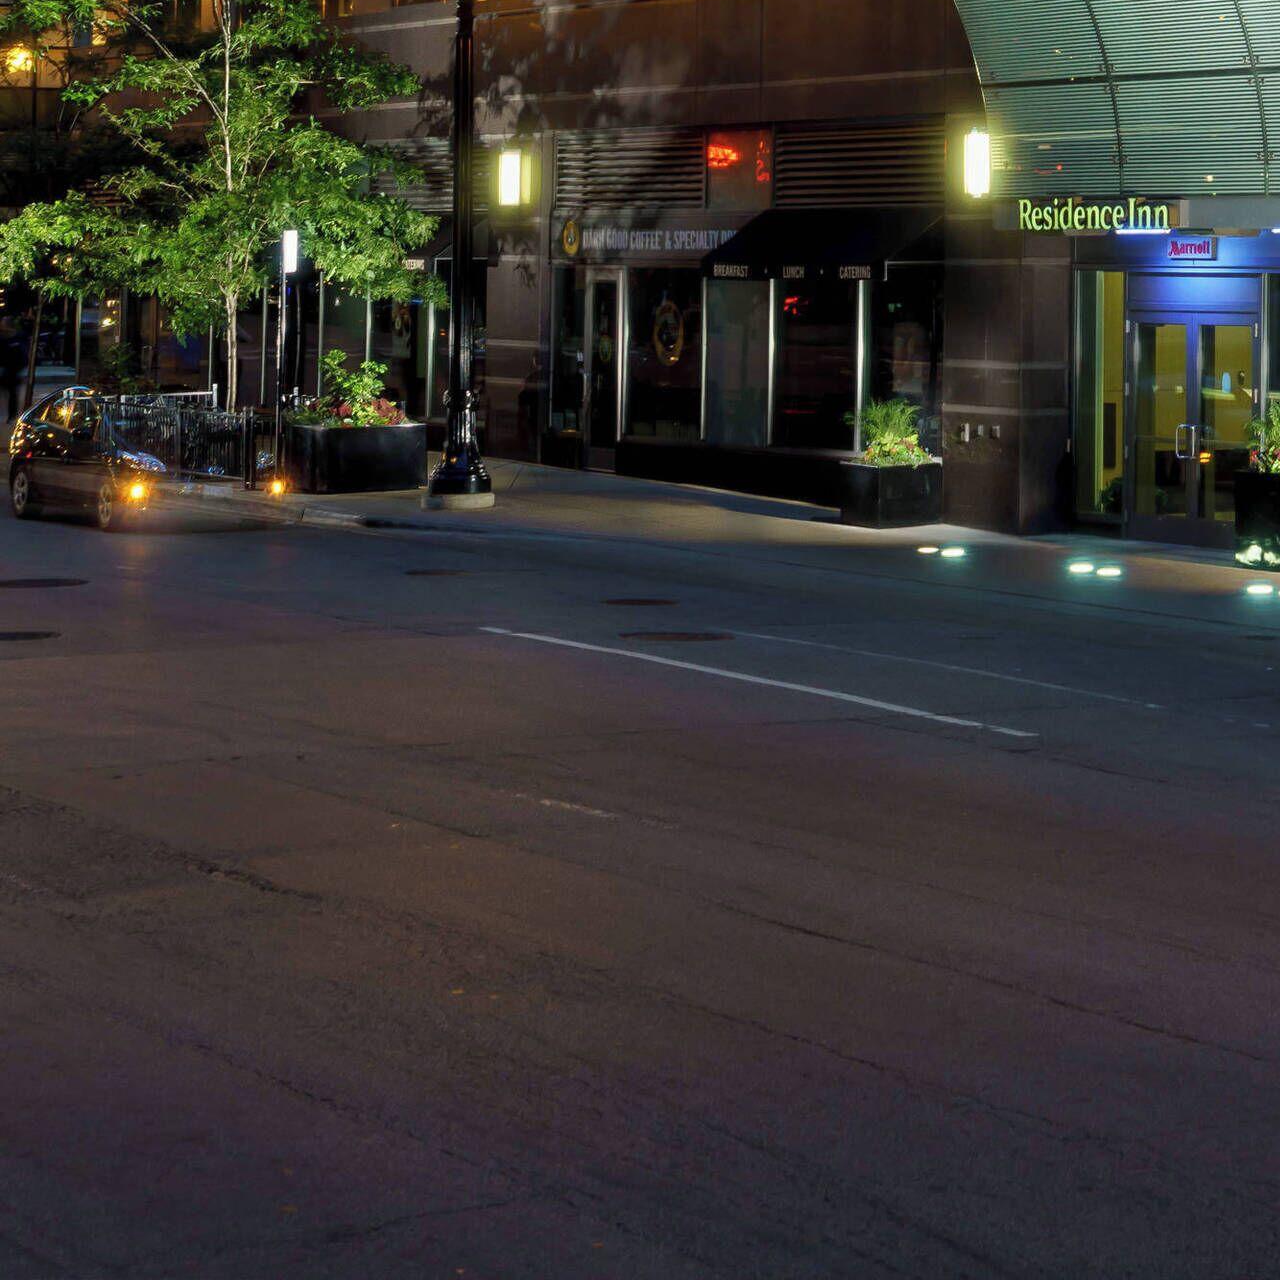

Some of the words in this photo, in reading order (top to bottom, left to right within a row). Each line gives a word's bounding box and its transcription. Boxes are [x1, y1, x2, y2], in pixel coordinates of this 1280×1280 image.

[1018, 197, 1125, 231] Residence
[1129, 197, 1169, 230] Inn
[630, 230, 661, 250] COFFEE
[665, 231, 672, 250] &
[673, 230, 719, 250] SPECIALTY
[1168, 241, 1210, 256] Marriott
[713, 264, 749, 278] BREAKFAST
[782, 266, 805, 279] LUNCH
[839, 266, 871, 280] CATERING
